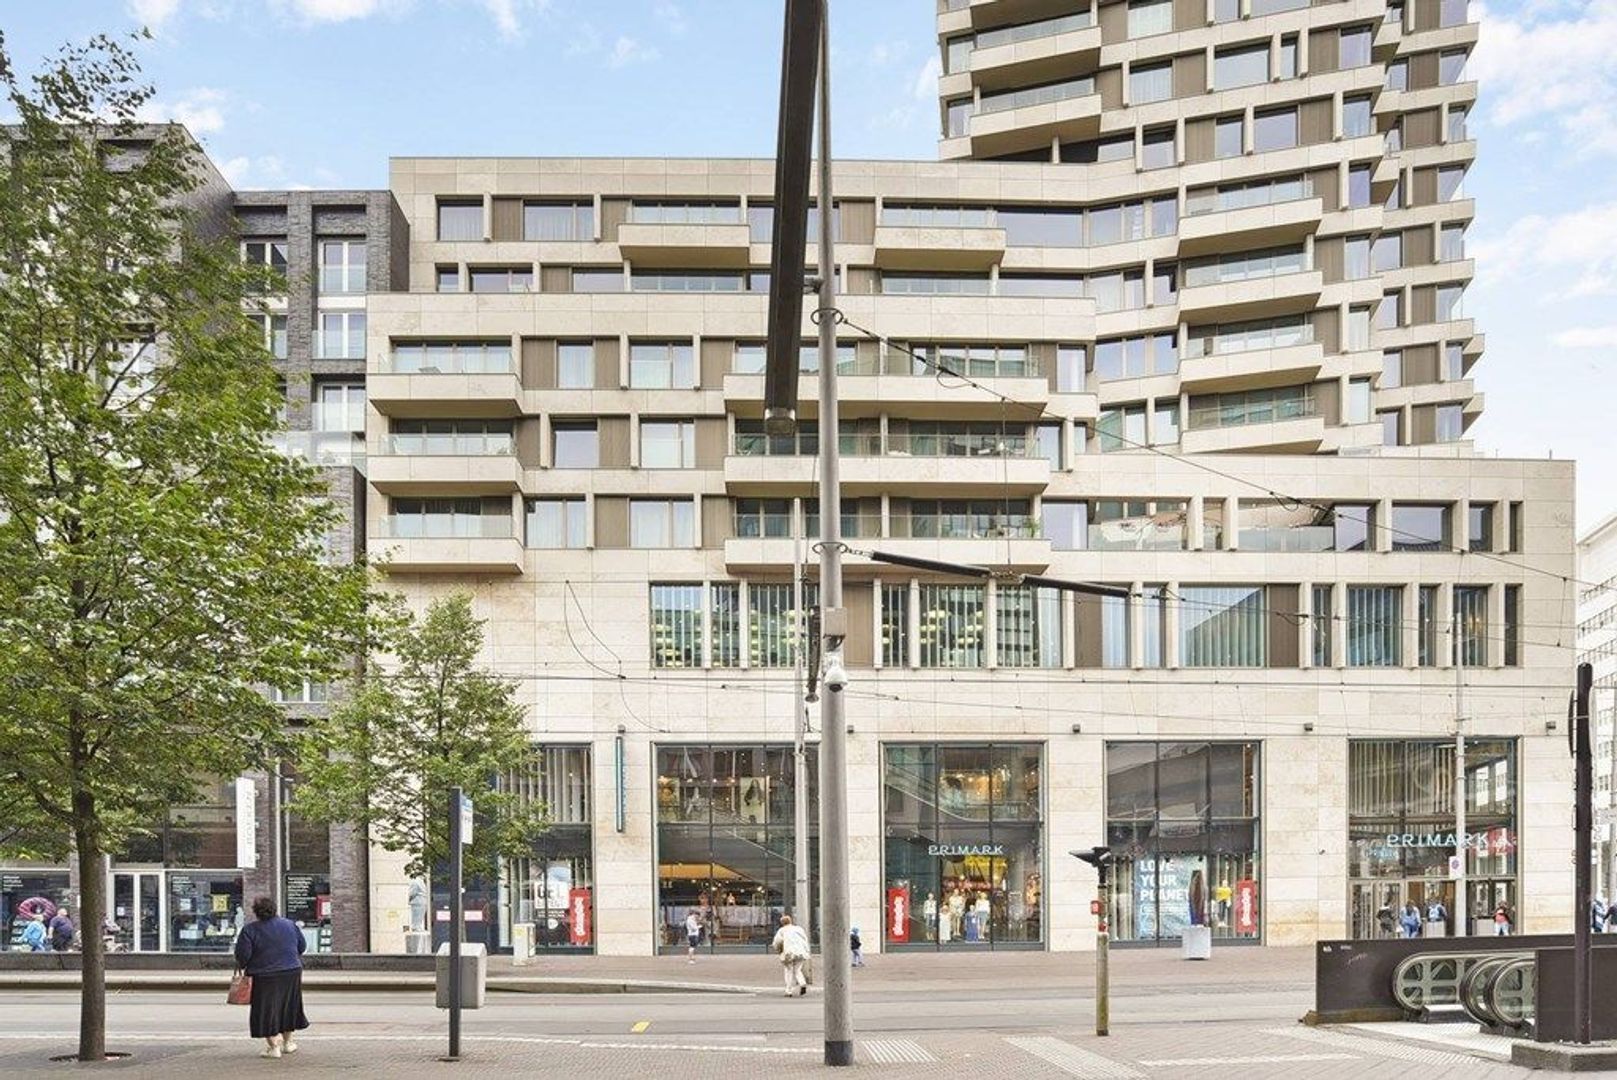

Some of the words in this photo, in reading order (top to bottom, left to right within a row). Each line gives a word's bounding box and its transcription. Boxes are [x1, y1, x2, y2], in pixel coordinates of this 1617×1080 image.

[1386, 833, 1489, 848] PRIMARK
[928, 844, 1004, 856] PRIMARK
[1140, 859, 1175, 871] LOVE
